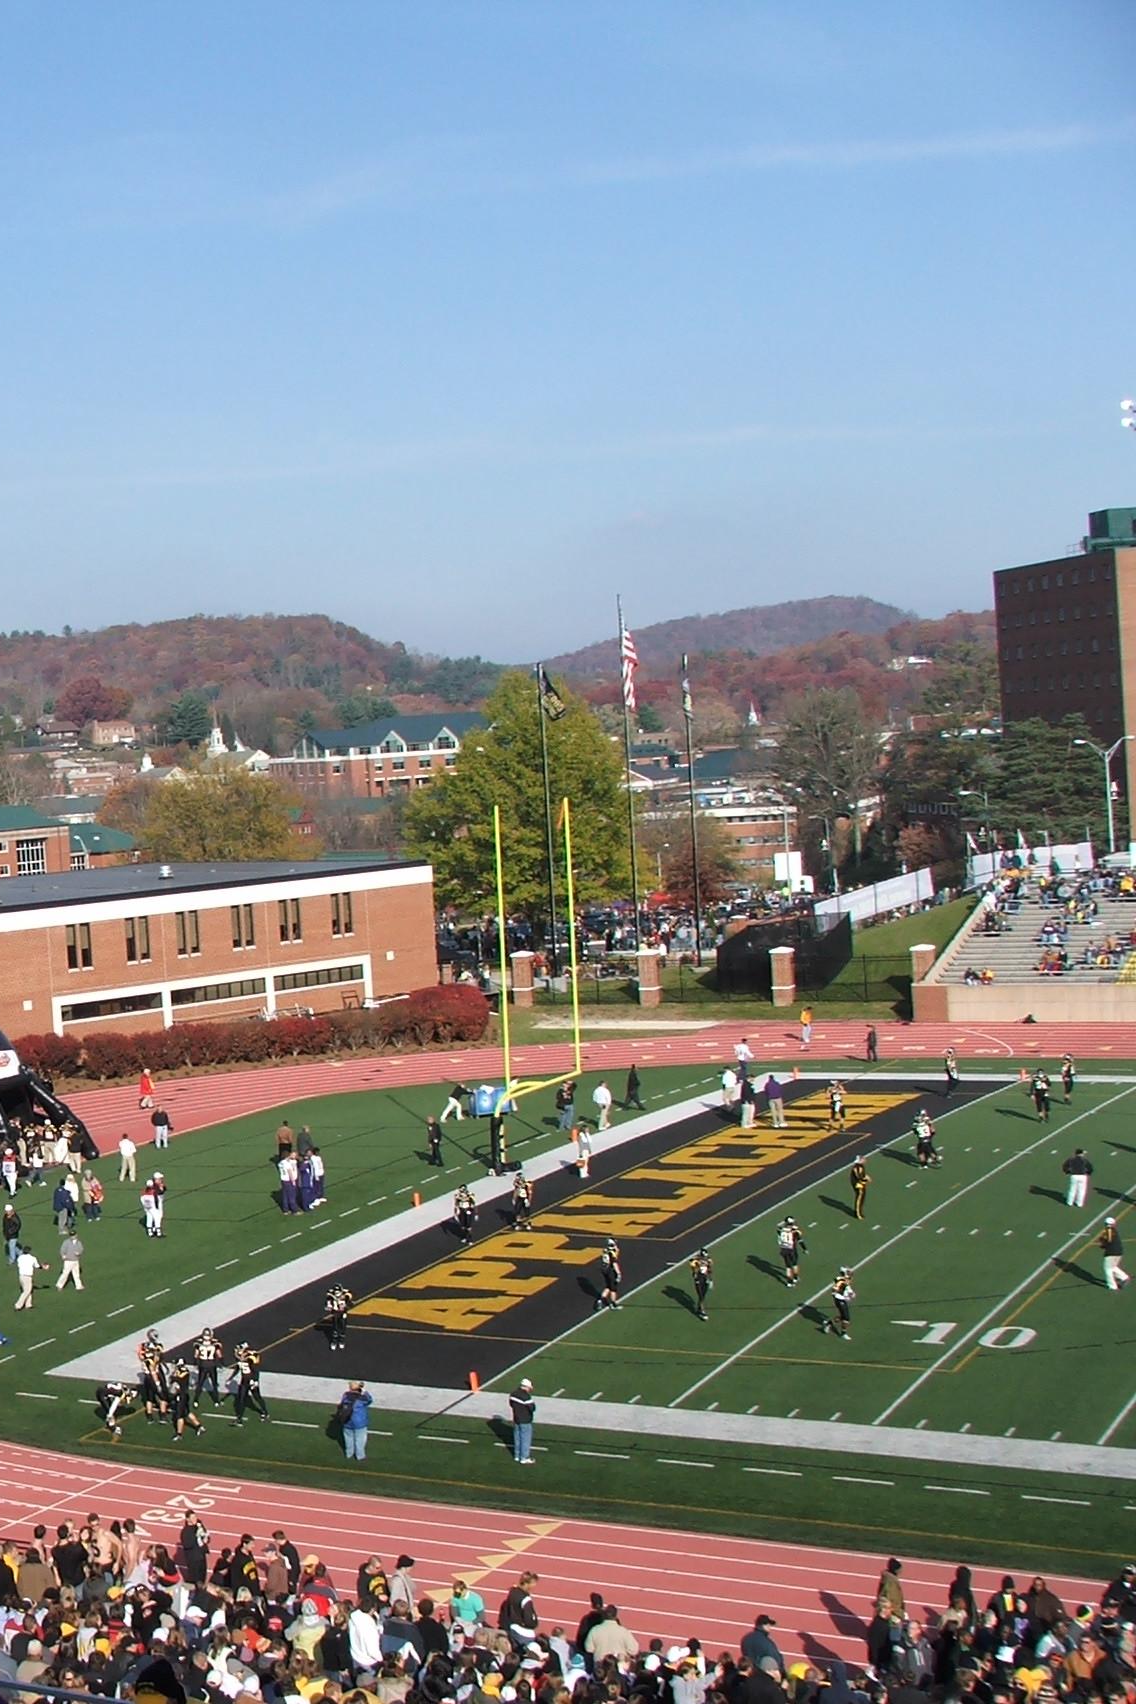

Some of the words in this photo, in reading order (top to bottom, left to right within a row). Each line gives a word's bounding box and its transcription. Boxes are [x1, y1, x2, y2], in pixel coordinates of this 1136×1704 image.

[348, 1093, 921, 1331] APPALACHIAN
[912, 1321, 1038, 1349] 10
[199, 1345, 217, 1360] 37
[165, 1494, 215, 1509] 2
